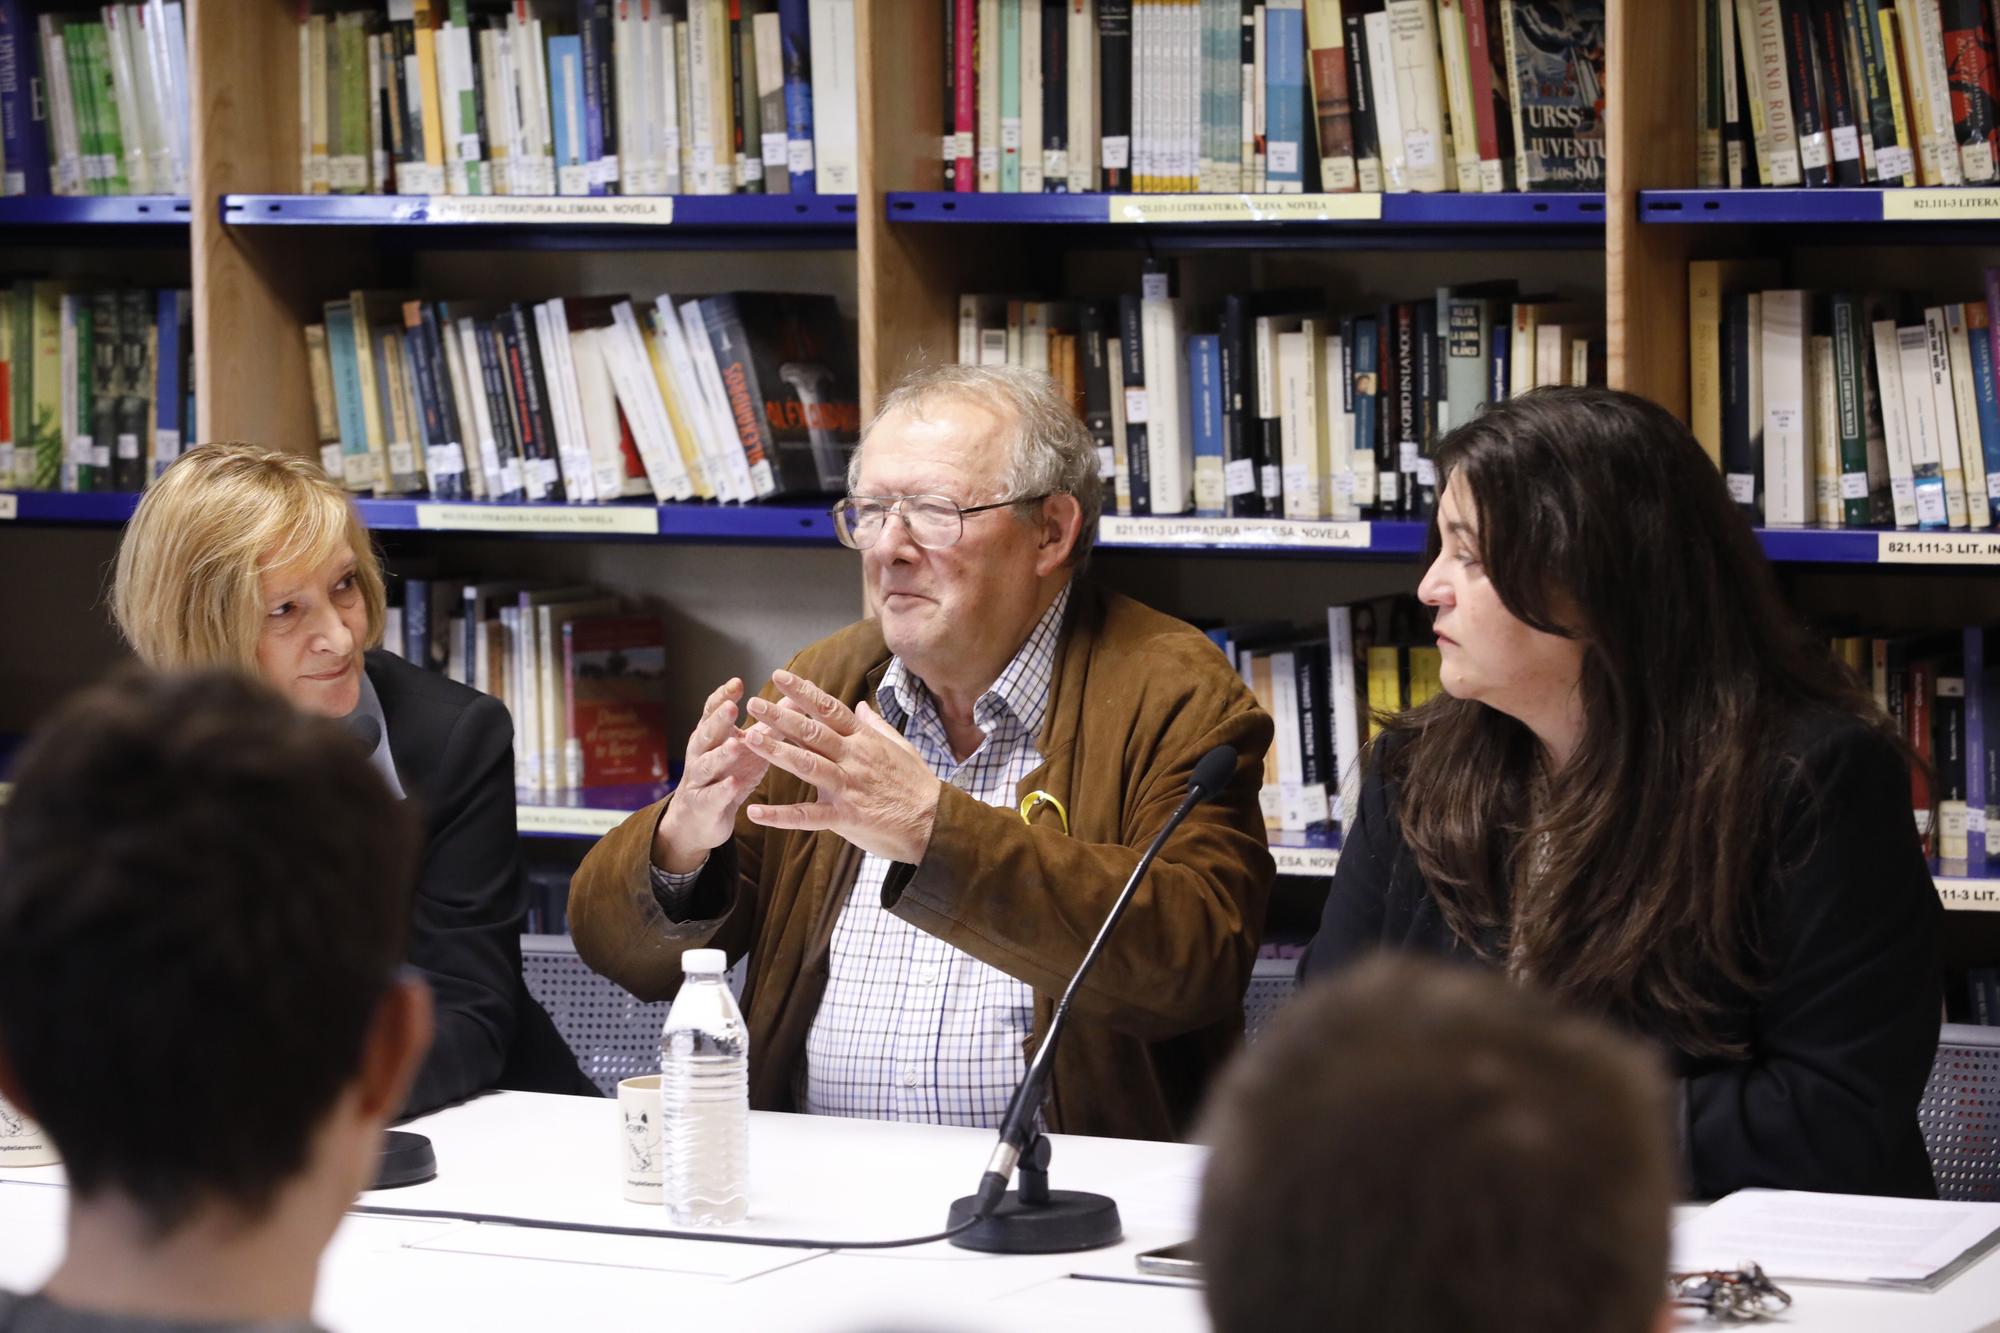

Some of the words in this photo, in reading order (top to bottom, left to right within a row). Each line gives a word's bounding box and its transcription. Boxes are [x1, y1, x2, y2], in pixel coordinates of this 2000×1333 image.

[1528, 104, 1585, 128] URSS:
[1768, 100, 1788, 143] ROJO
[1575, 158, 1600, 180] 80
[488, 203, 553, 214] LITERATURA
[612, 204, 656, 215] NOVELA
[1176, 202, 1238, 213] LITERATURA
[1286, 201, 1327, 210] NOVELA
[1913, 198, 1956, 209] 821.111-3
[1959, 197, 2000, 208] LITERA
[1451, 316, 1478, 327] COLLINS
[1452, 346, 1478, 356] BLANCO
[1400, 358, 1412, 374] LA
[1931, 354, 1941, 370] SIN
[1400, 375, 1412, 391] EN
[1115, 524, 1166, 536] 821.111-3
[1168, 525, 1240, 536] LITERATURA
[1302, 528, 1350, 540] NOVELA
[1888, 542, 1953, 554] 821.111-3
[1957, 543, 1984, 554] LIT.
[1303, 712, 1315, 756] PATRICIA
[1973, 890, 1999, 902] LIT.
